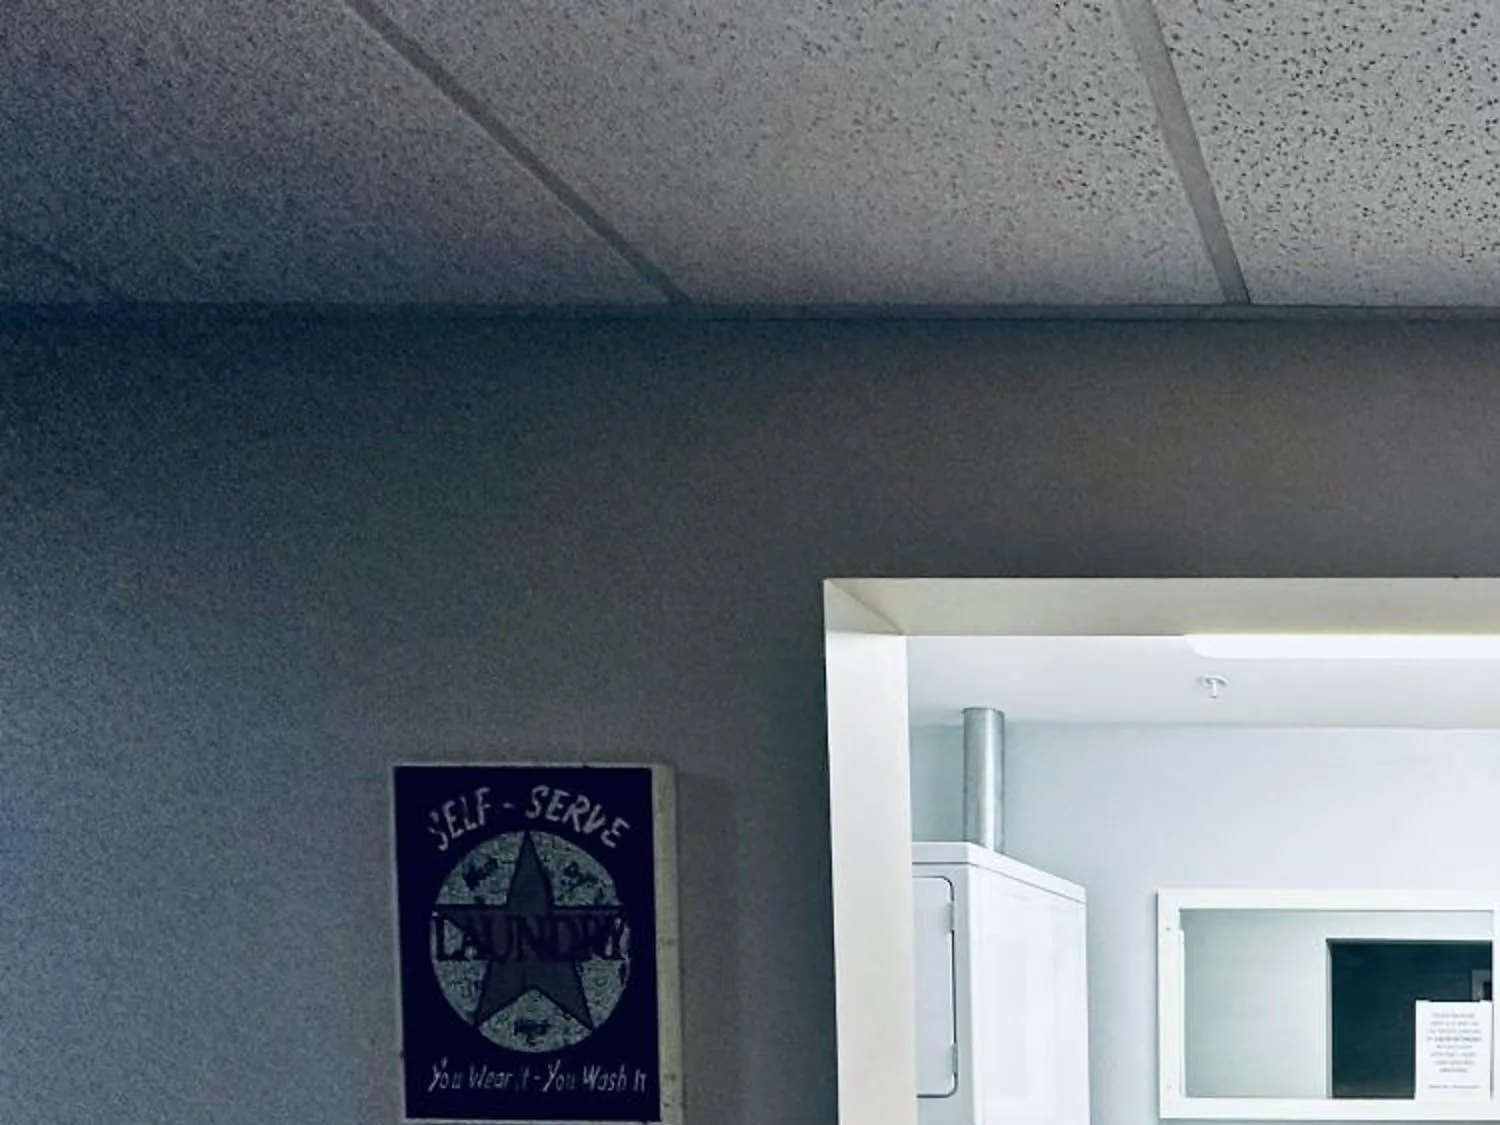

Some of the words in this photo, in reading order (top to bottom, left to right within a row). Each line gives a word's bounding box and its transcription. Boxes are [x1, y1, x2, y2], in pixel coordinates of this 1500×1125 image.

[429, 786, 491, 850] SELF
[525, 785, 631, 848] SERVE
[428, 1056, 462, 1093] You
[469, 1062, 513, 1089] Wear
[543, 1059, 575, 1093] You
[584, 1063, 628, 1092] Wash
